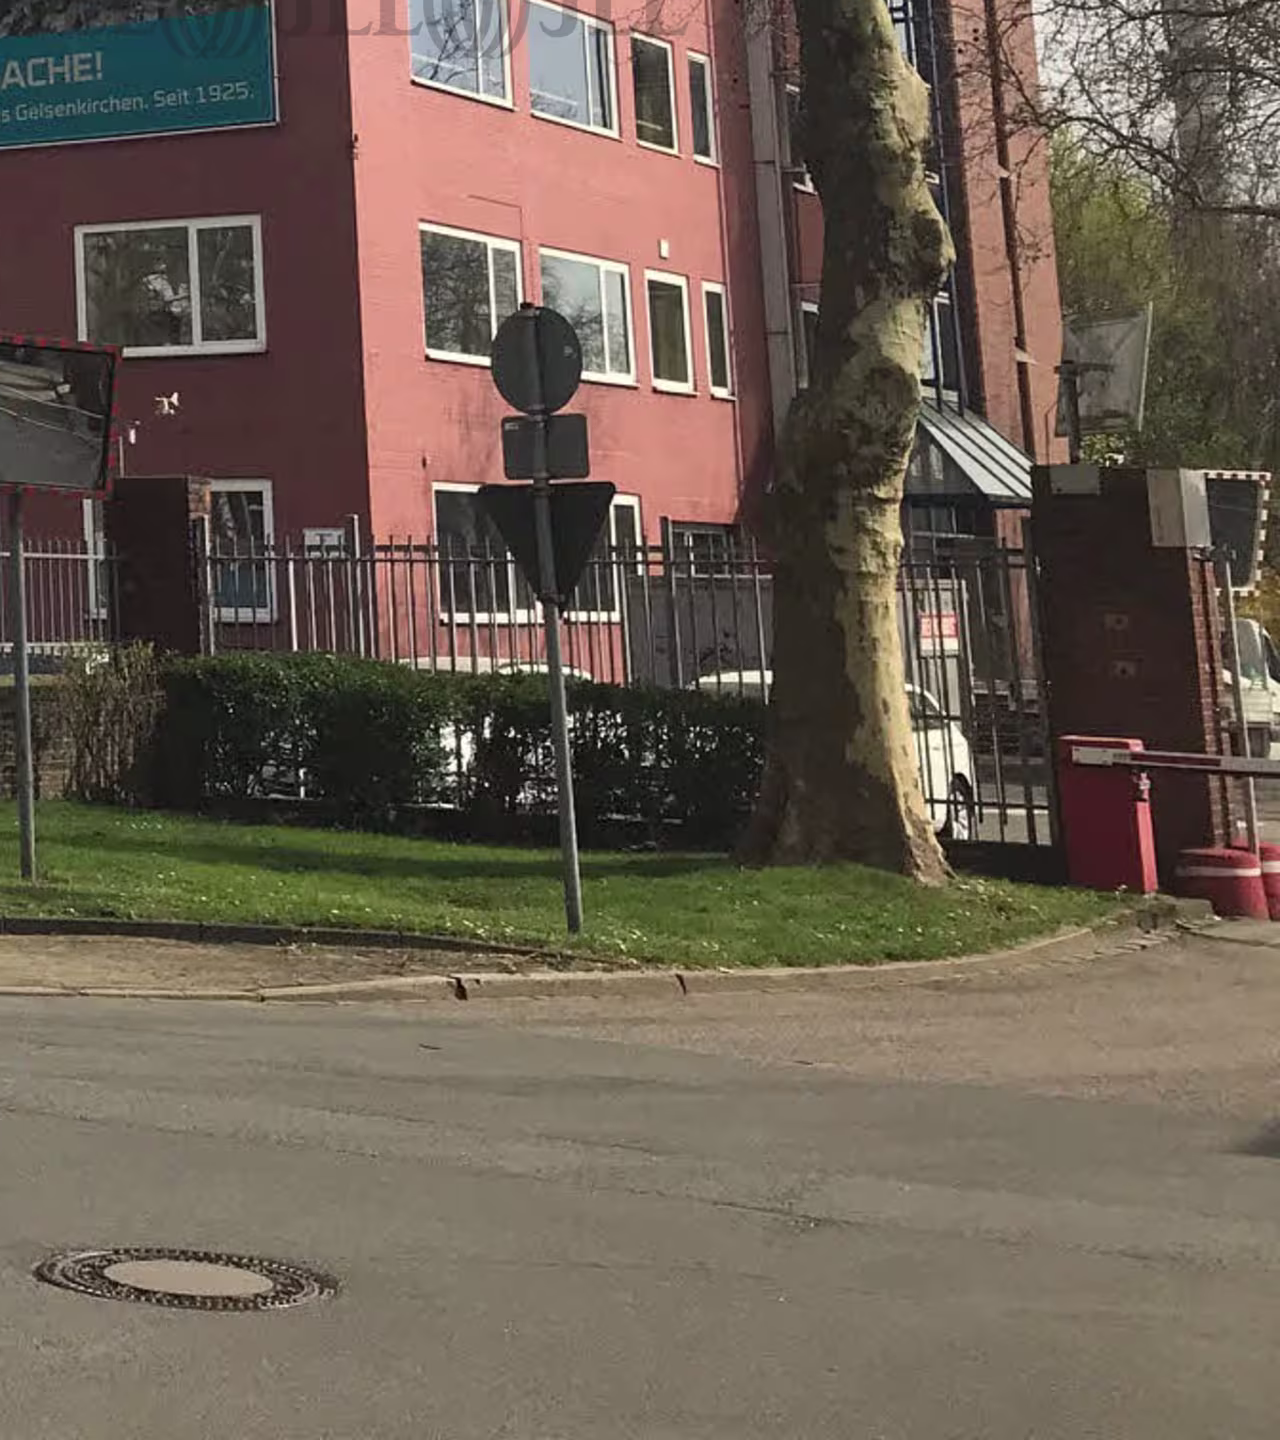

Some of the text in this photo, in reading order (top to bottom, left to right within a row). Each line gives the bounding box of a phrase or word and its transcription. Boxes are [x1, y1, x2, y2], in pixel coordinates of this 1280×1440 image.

[15, 94, 149, 121] Gelsenkirchen.
[153, 88, 190, 108] Seit
[195, 81, 255, 104] 1925.
